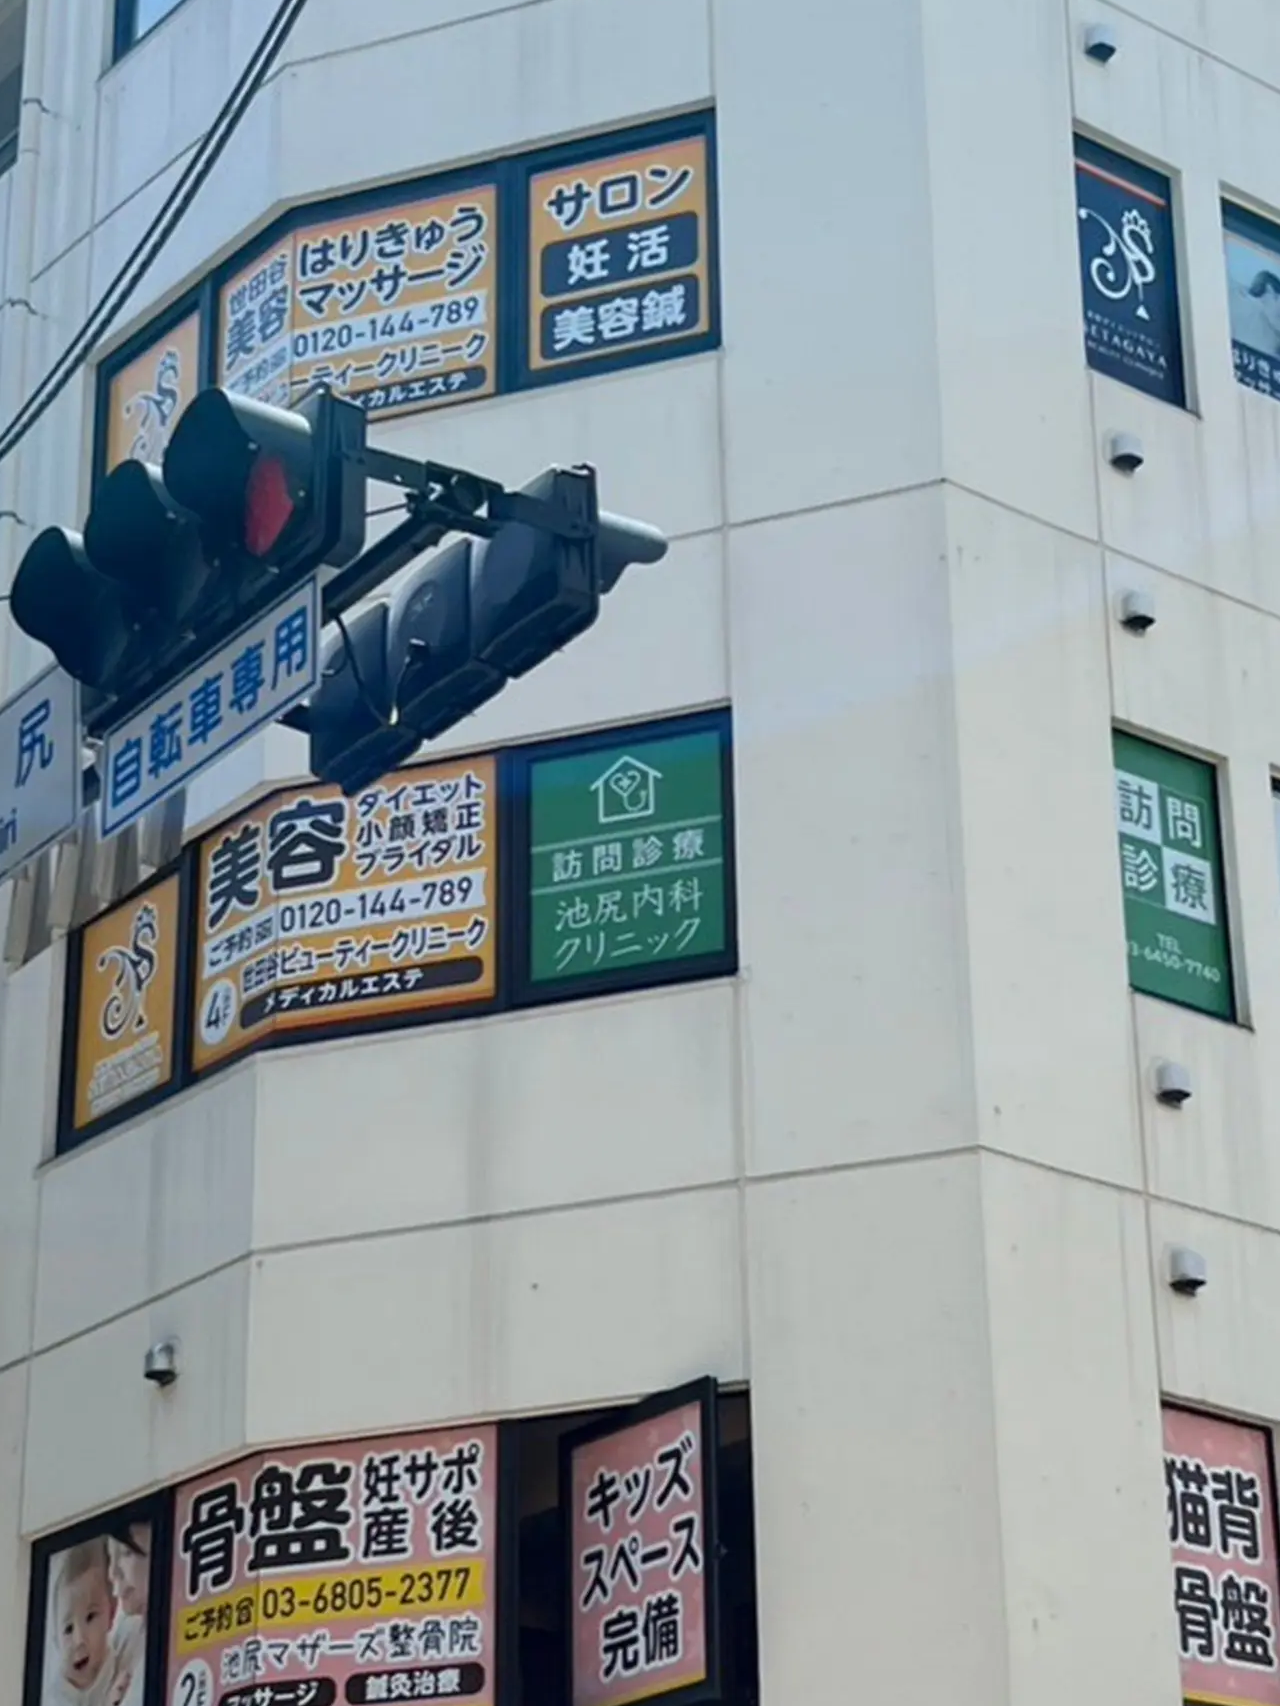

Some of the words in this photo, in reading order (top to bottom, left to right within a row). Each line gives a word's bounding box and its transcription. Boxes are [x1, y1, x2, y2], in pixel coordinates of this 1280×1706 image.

[547, 168, 691, 227] サロン
[298, 205, 486, 278] はりきゅう
[567, 224, 671, 286] 妊活
[297, 243, 486, 315] マッサージ
[226, 284, 289, 371] 美容
[293, 295, 480, 359] 0120-144-789
[553, 284, 687, 352] 美容鍼
[110, 604, 309, 810] 自転車専用
[355, 802, 483, 845] 小顔矯正
[356, 773, 483, 818] ダイエット
[1117, 779, 1202, 849] 訪問
[207, 798, 347, 931] 美容
[355, 834, 483, 879] ブライダル
[552, 828, 705, 883] 訪問診療
[1122, 842, 1209, 911] 診療
[280, 875, 474, 932] 0120-144-789
[555, 875, 705, 932] 池尻内科
[241, 916, 487, 993] 世田谷ビューティークリニーク
[554, 916, 702, 973] クリニック
[1130, 940, 1221, 983] 3-6450-7740
[1156, 932, 1183, 955] TEL
[262, 969, 425, 1014] メディカルエステ
[586, 1434, 694, 1529] キッズ
[1163, 1456, 1260, 1560] 猫背
[181, 1461, 353, 1597] 骨盤
[361, 1497, 479, 1561] 産後
[581, 1516, 702, 1608] スペース
[183, 1602, 232, 1642] ご予約
[262, 1566, 471, 1620] 03-6805-2377
[601, 1591, 681, 1679] 完備
[1175, 1566, 1274, 1668] 骨盤
[220, 1617, 480, 1683] 池尻マザーズ整骨院
[364, 1667, 462, 1701] 鍼灸治療
